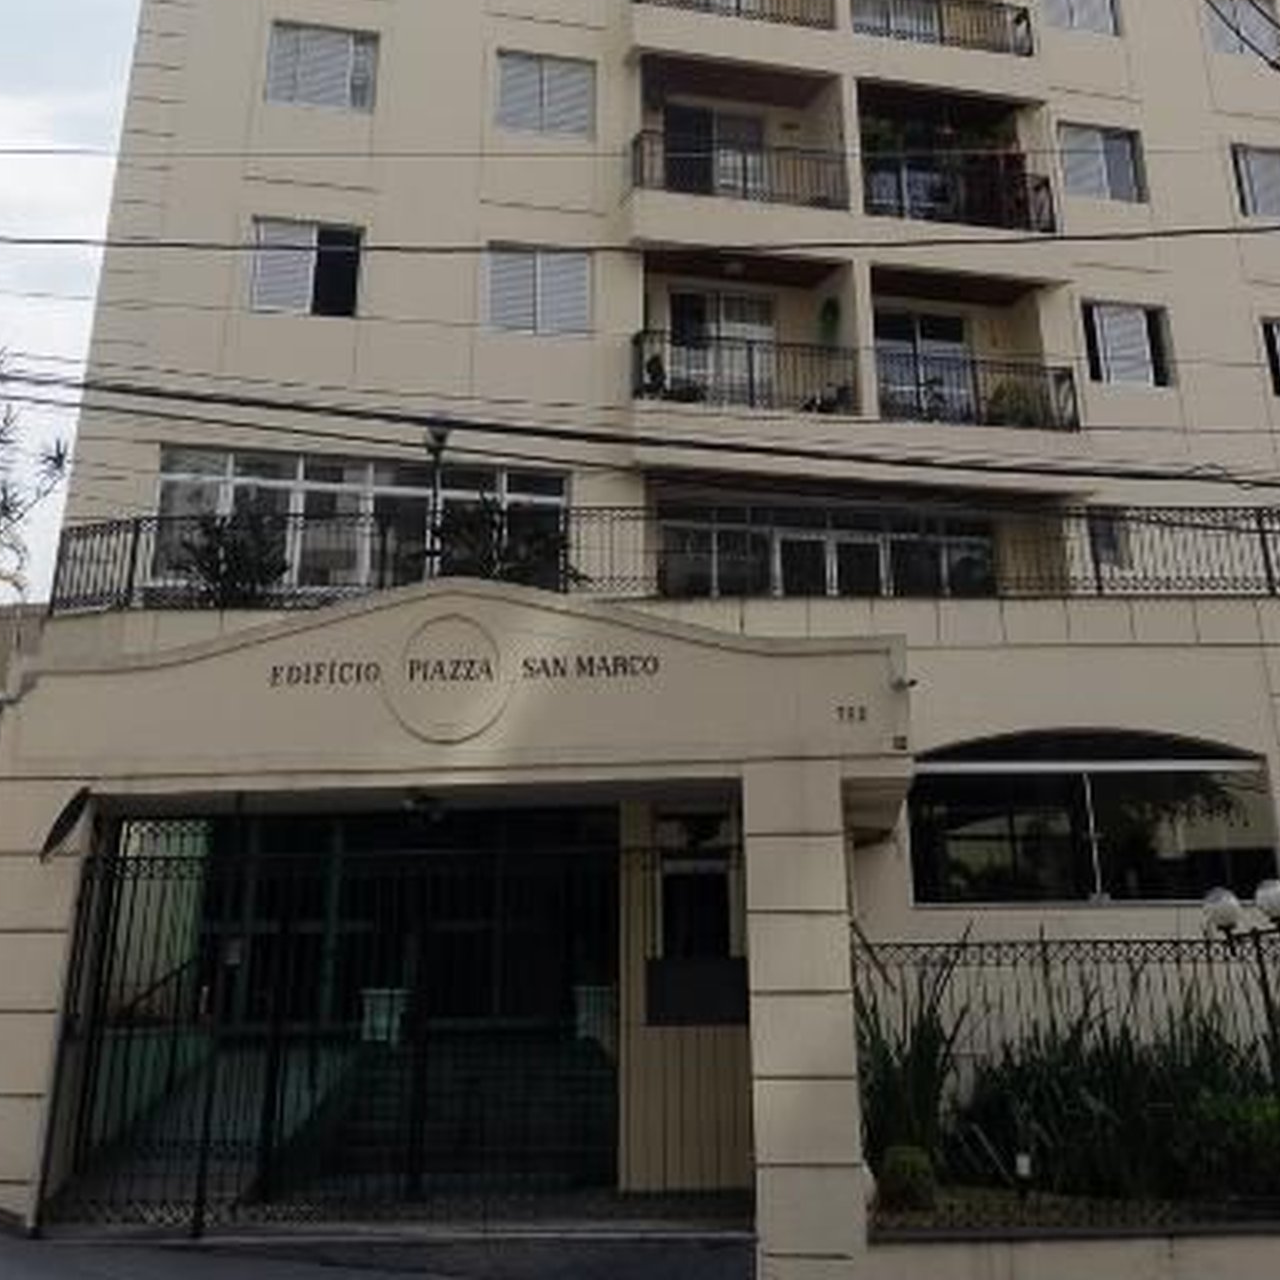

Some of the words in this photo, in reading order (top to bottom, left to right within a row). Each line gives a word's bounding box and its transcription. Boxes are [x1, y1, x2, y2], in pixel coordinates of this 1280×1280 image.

[408, 658, 494, 682] PIAZZA
[522, 656, 567, 678] SAN
[575, 654, 660, 678] MARCO
